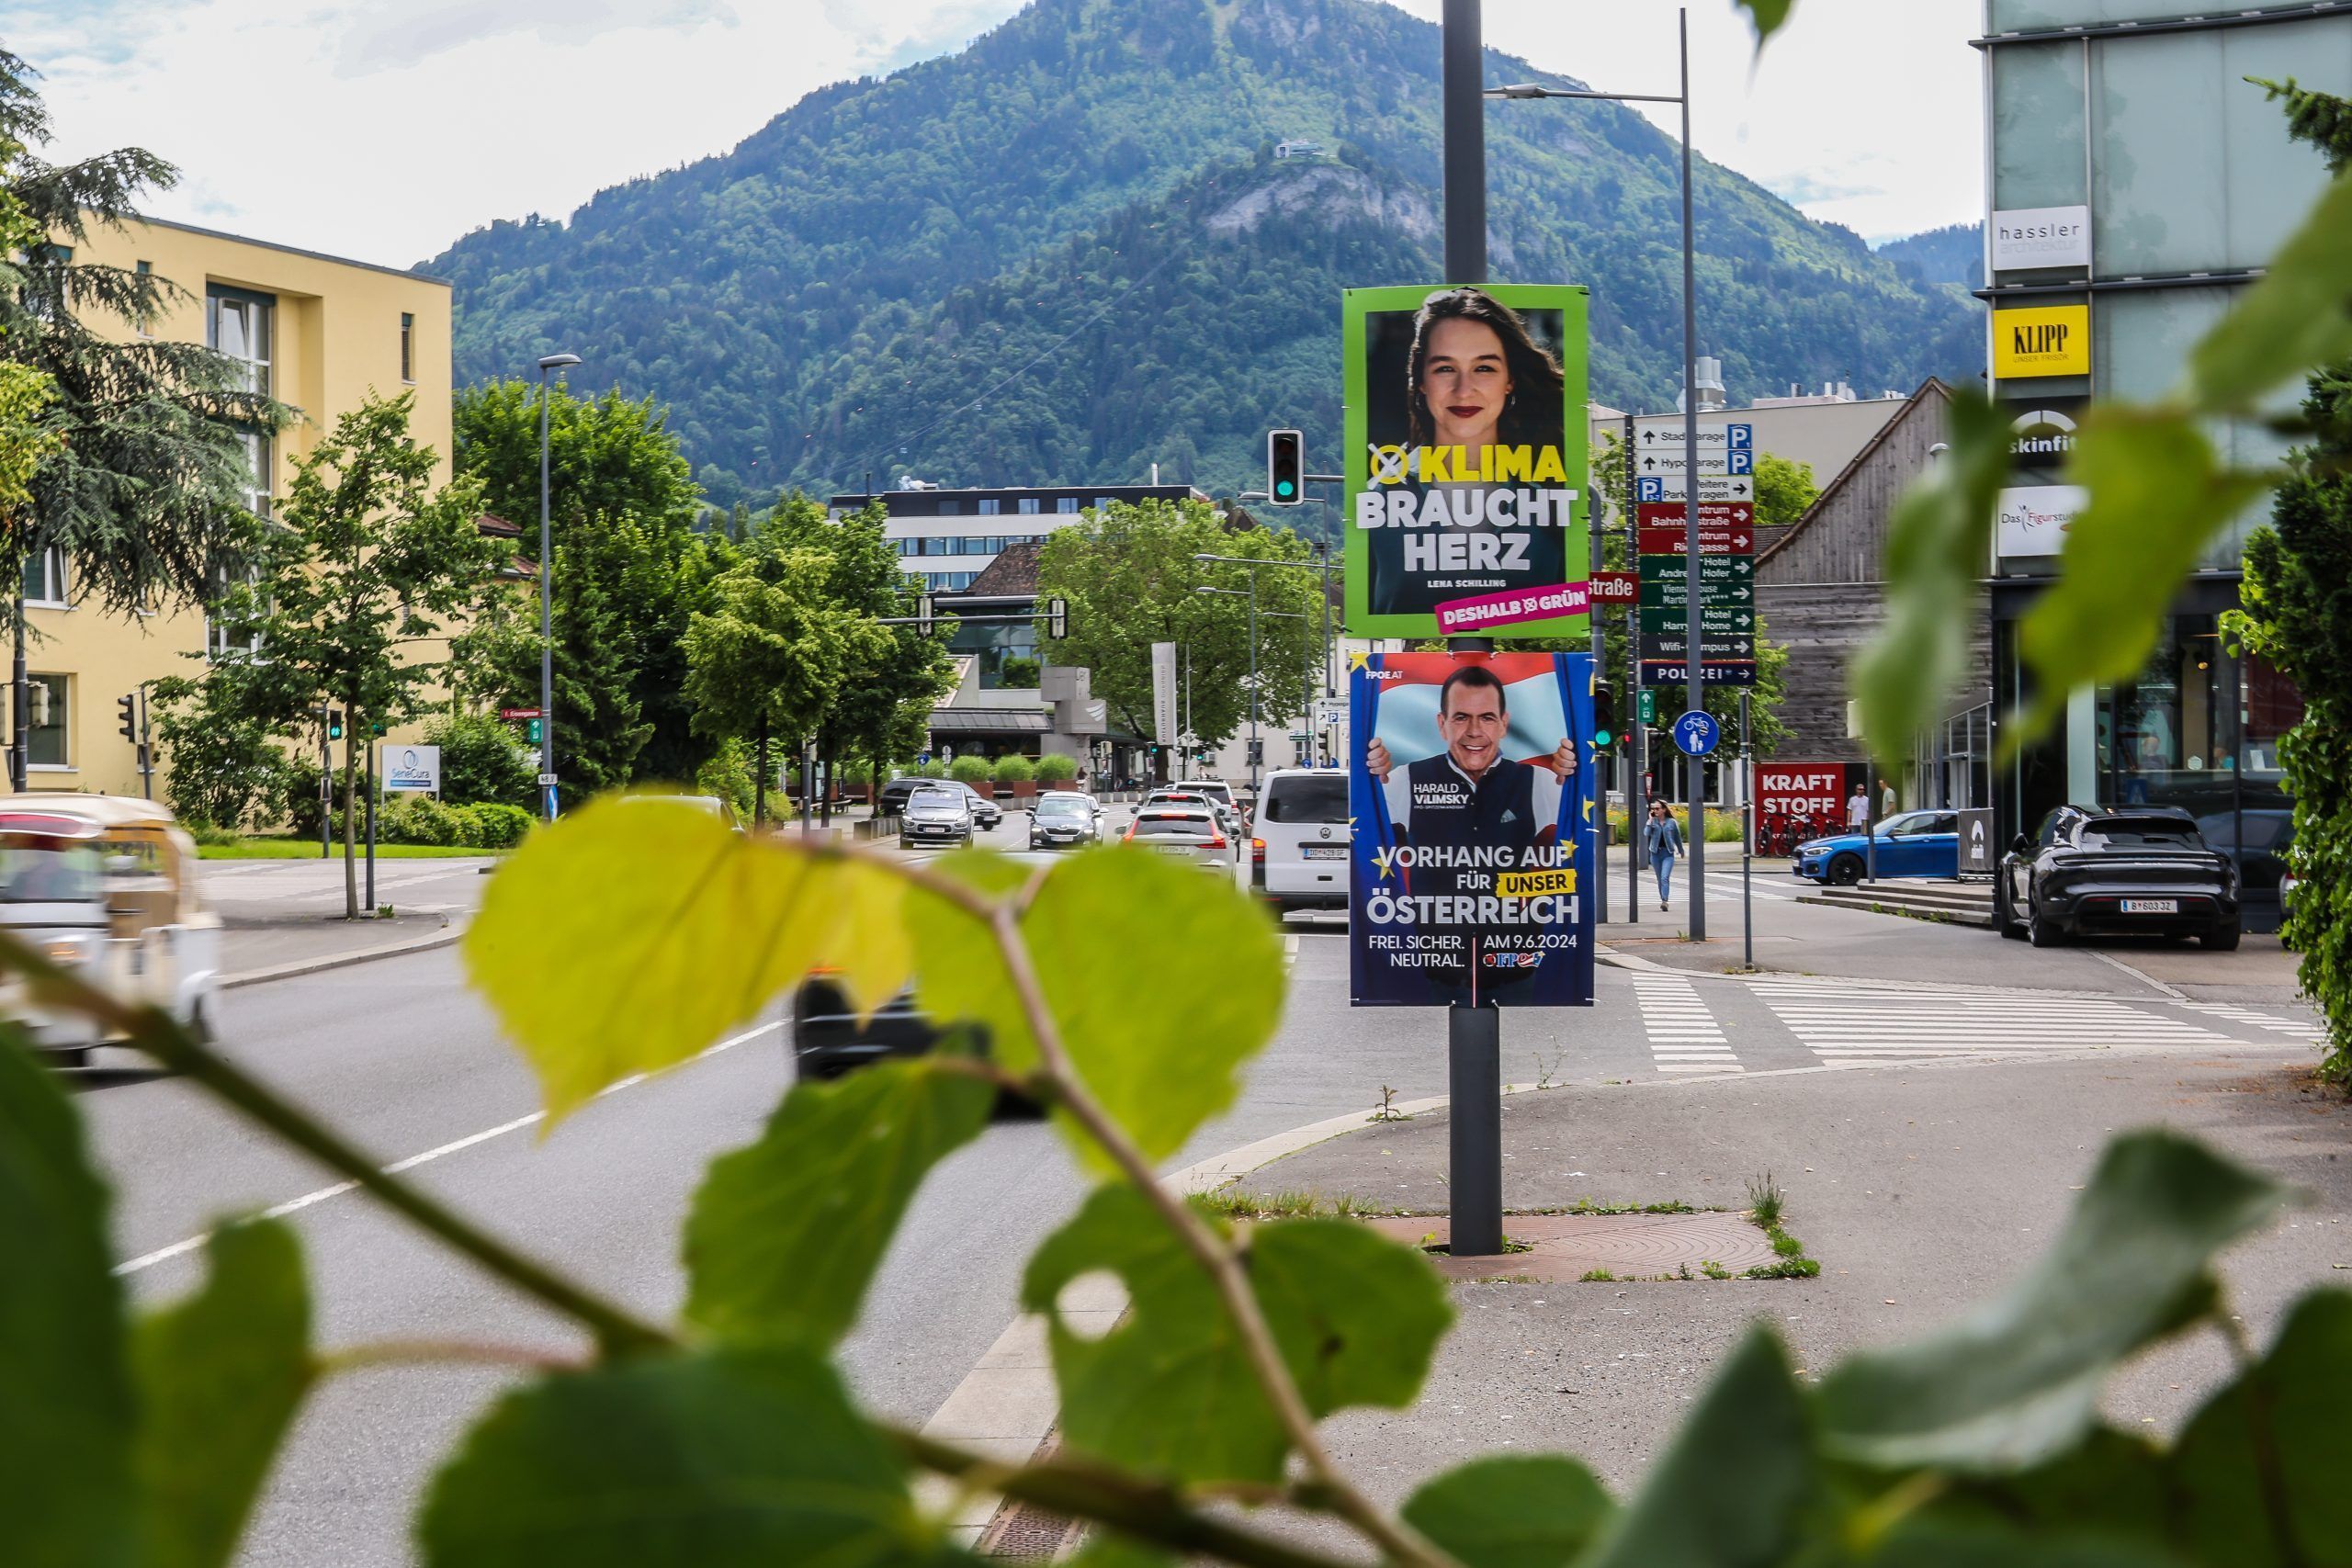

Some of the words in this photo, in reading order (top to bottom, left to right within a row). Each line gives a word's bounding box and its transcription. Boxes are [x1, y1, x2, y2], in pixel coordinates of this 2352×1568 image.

[1999, 223, 2080, 240] hassler
[2014, 324, 2068, 354] KLIPP
[1661, 432, 1725, 442] Stadarage
[1419, 445, 1568, 483] KLIMA
[1661, 458, 1725, 468] Hypoarage
[1697, 479, 1728, 489] eitere
[1663, 490, 1729, 500] Parkragen
[1355, 489, 1578, 529] BRAUCHT
[1651, 516, 1730, 526] Bahnhstraße
[2001, 513, 2021, 524] Das
[1403, 533, 1531, 572] HERZ
[1702, 569, 1730, 577] Hofer
[1427, 580, 1453, 588] LENA
[1455, 579, 1506, 588] SCHILLING
[1442, 600, 1521, 626] DESHALB
[1539, 590, 1587, 610] GRÜN
[1704, 610, 1732, 618] Hotel
[1702, 621, 1731, 630] Home
[1659, 642, 1731, 653] Wifi-mpus
[1657, 668, 1723, 680] POLZEI
[1413, 783, 1459, 794] HARALD
[1762, 774, 1836, 791] KRAFT
[1414, 794, 1470, 805] VILIMSKY
[1762, 797, 1836, 814] STOFF
[1377, 845, 1515, 868] VORHANG
[1520, 845, 1569, 868] AUF
[1456, 870, 1491, 890] FÜR
[1506, 874, 1568, 894] UNSER
[1366, 887, 1579, 924] ÖSTERREICH
[1368, 935, 1403, 949] FREI.
[1406, 934, 1464, 949] SICHER.
[1483, 934, 1510, 949] AM
[1515, 934, 1577, 949] 9.6.2024
[1390, 953, 1464, 967] NEUTRAL.
